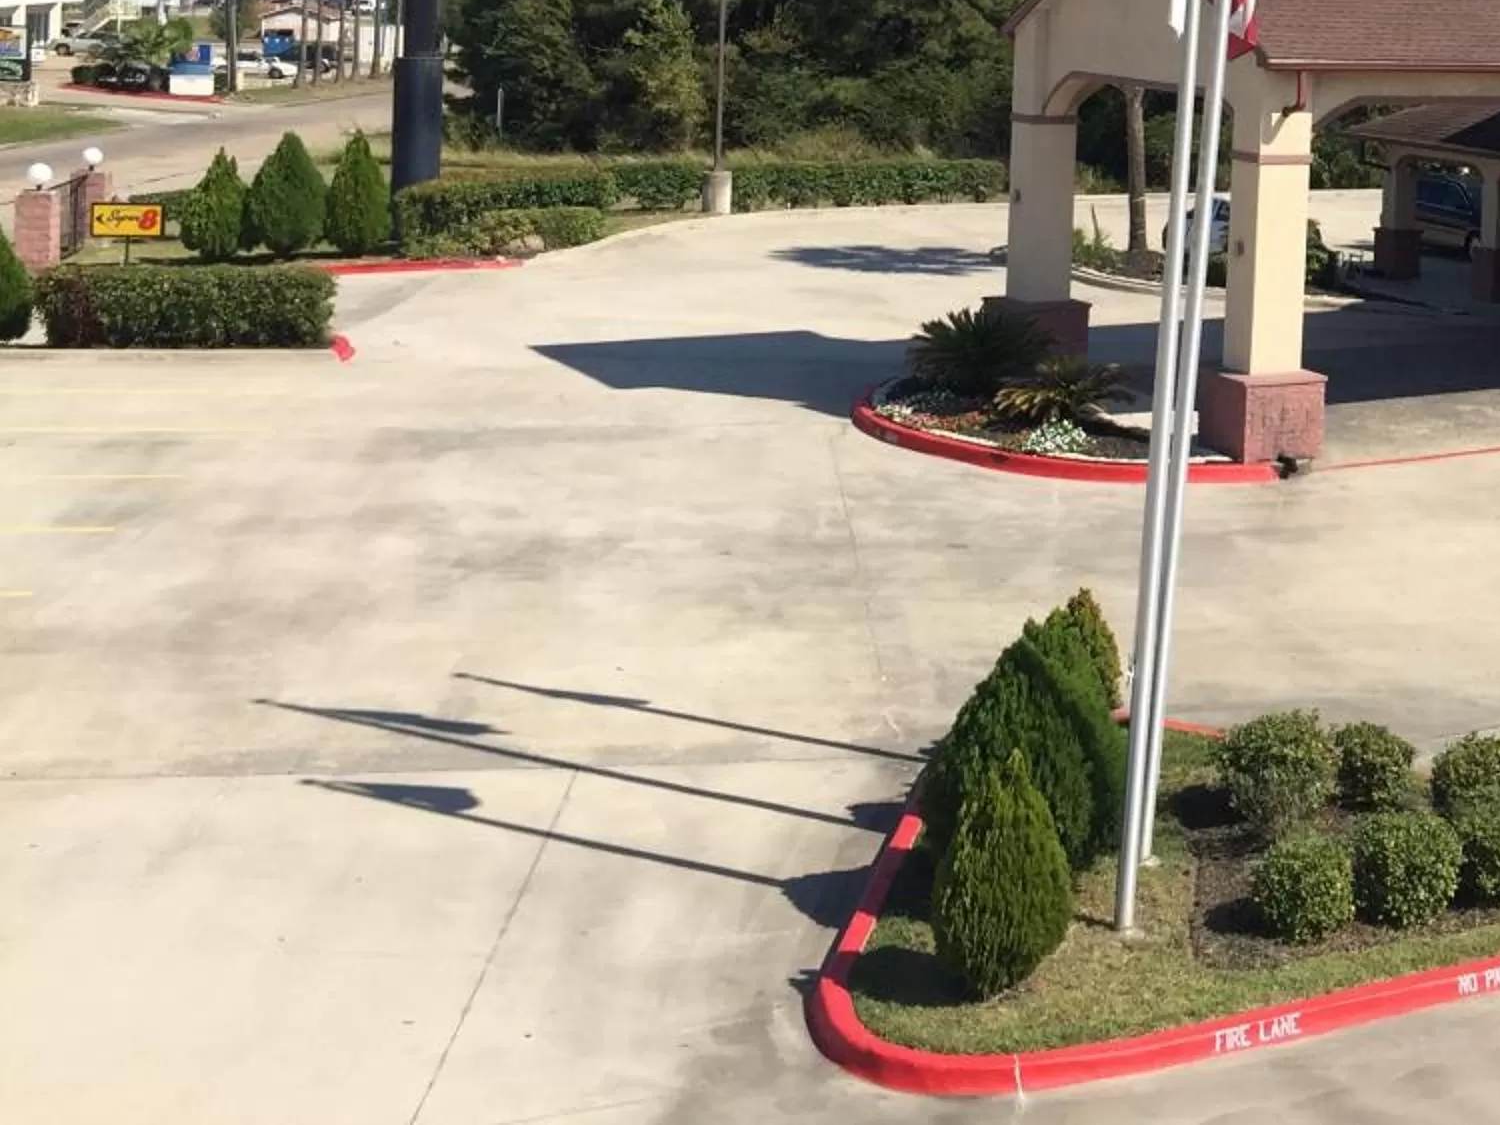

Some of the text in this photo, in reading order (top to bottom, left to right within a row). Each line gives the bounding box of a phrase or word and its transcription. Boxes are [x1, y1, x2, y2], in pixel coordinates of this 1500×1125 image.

[139, 208, 158, 230] 8
[1458, 972, 1479, 995] NO
[1215, 1011, 1303, 1052] FIRE LANE
